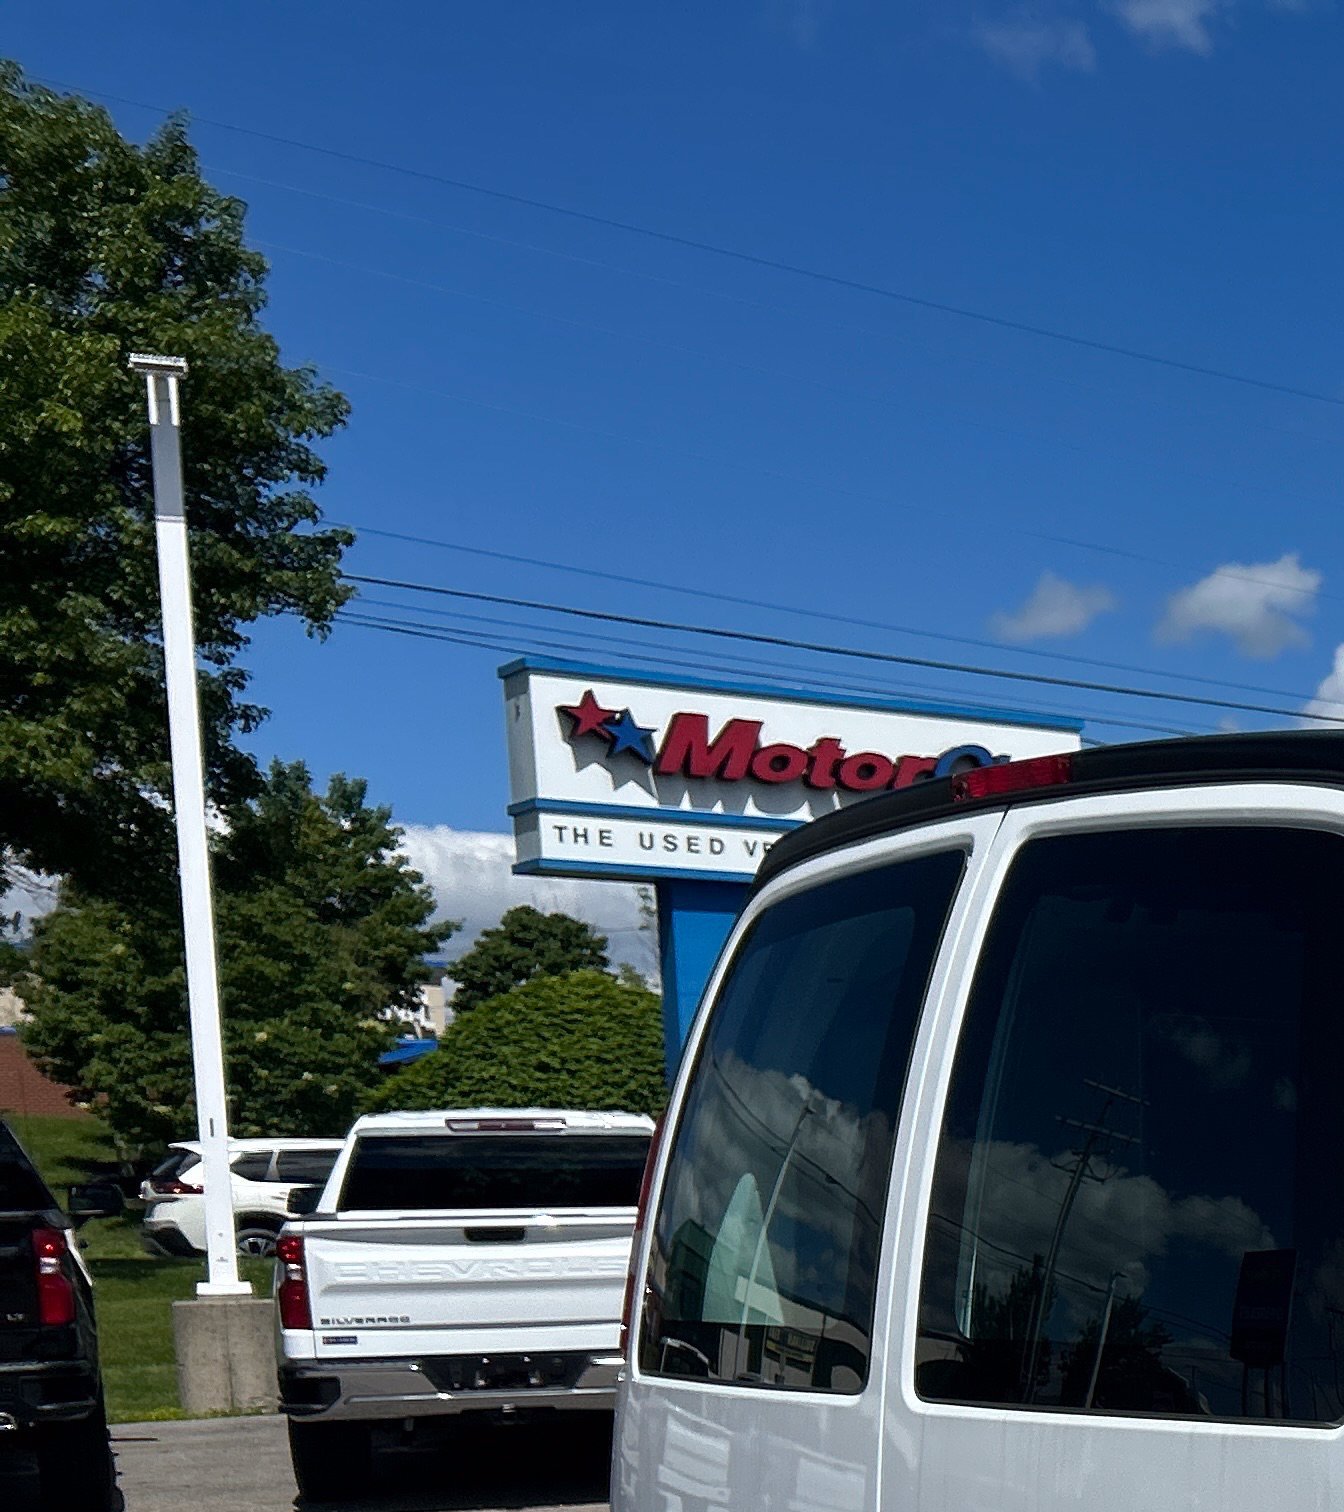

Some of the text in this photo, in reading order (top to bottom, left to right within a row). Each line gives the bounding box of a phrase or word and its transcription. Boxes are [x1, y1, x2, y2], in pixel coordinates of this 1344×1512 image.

[657, 712, 1009, 790] Motor
[552, 825, 613, 847] THE
[639, 831, 725, 855] USED
[334, 1257, 627, 1282] CHEVROLE
